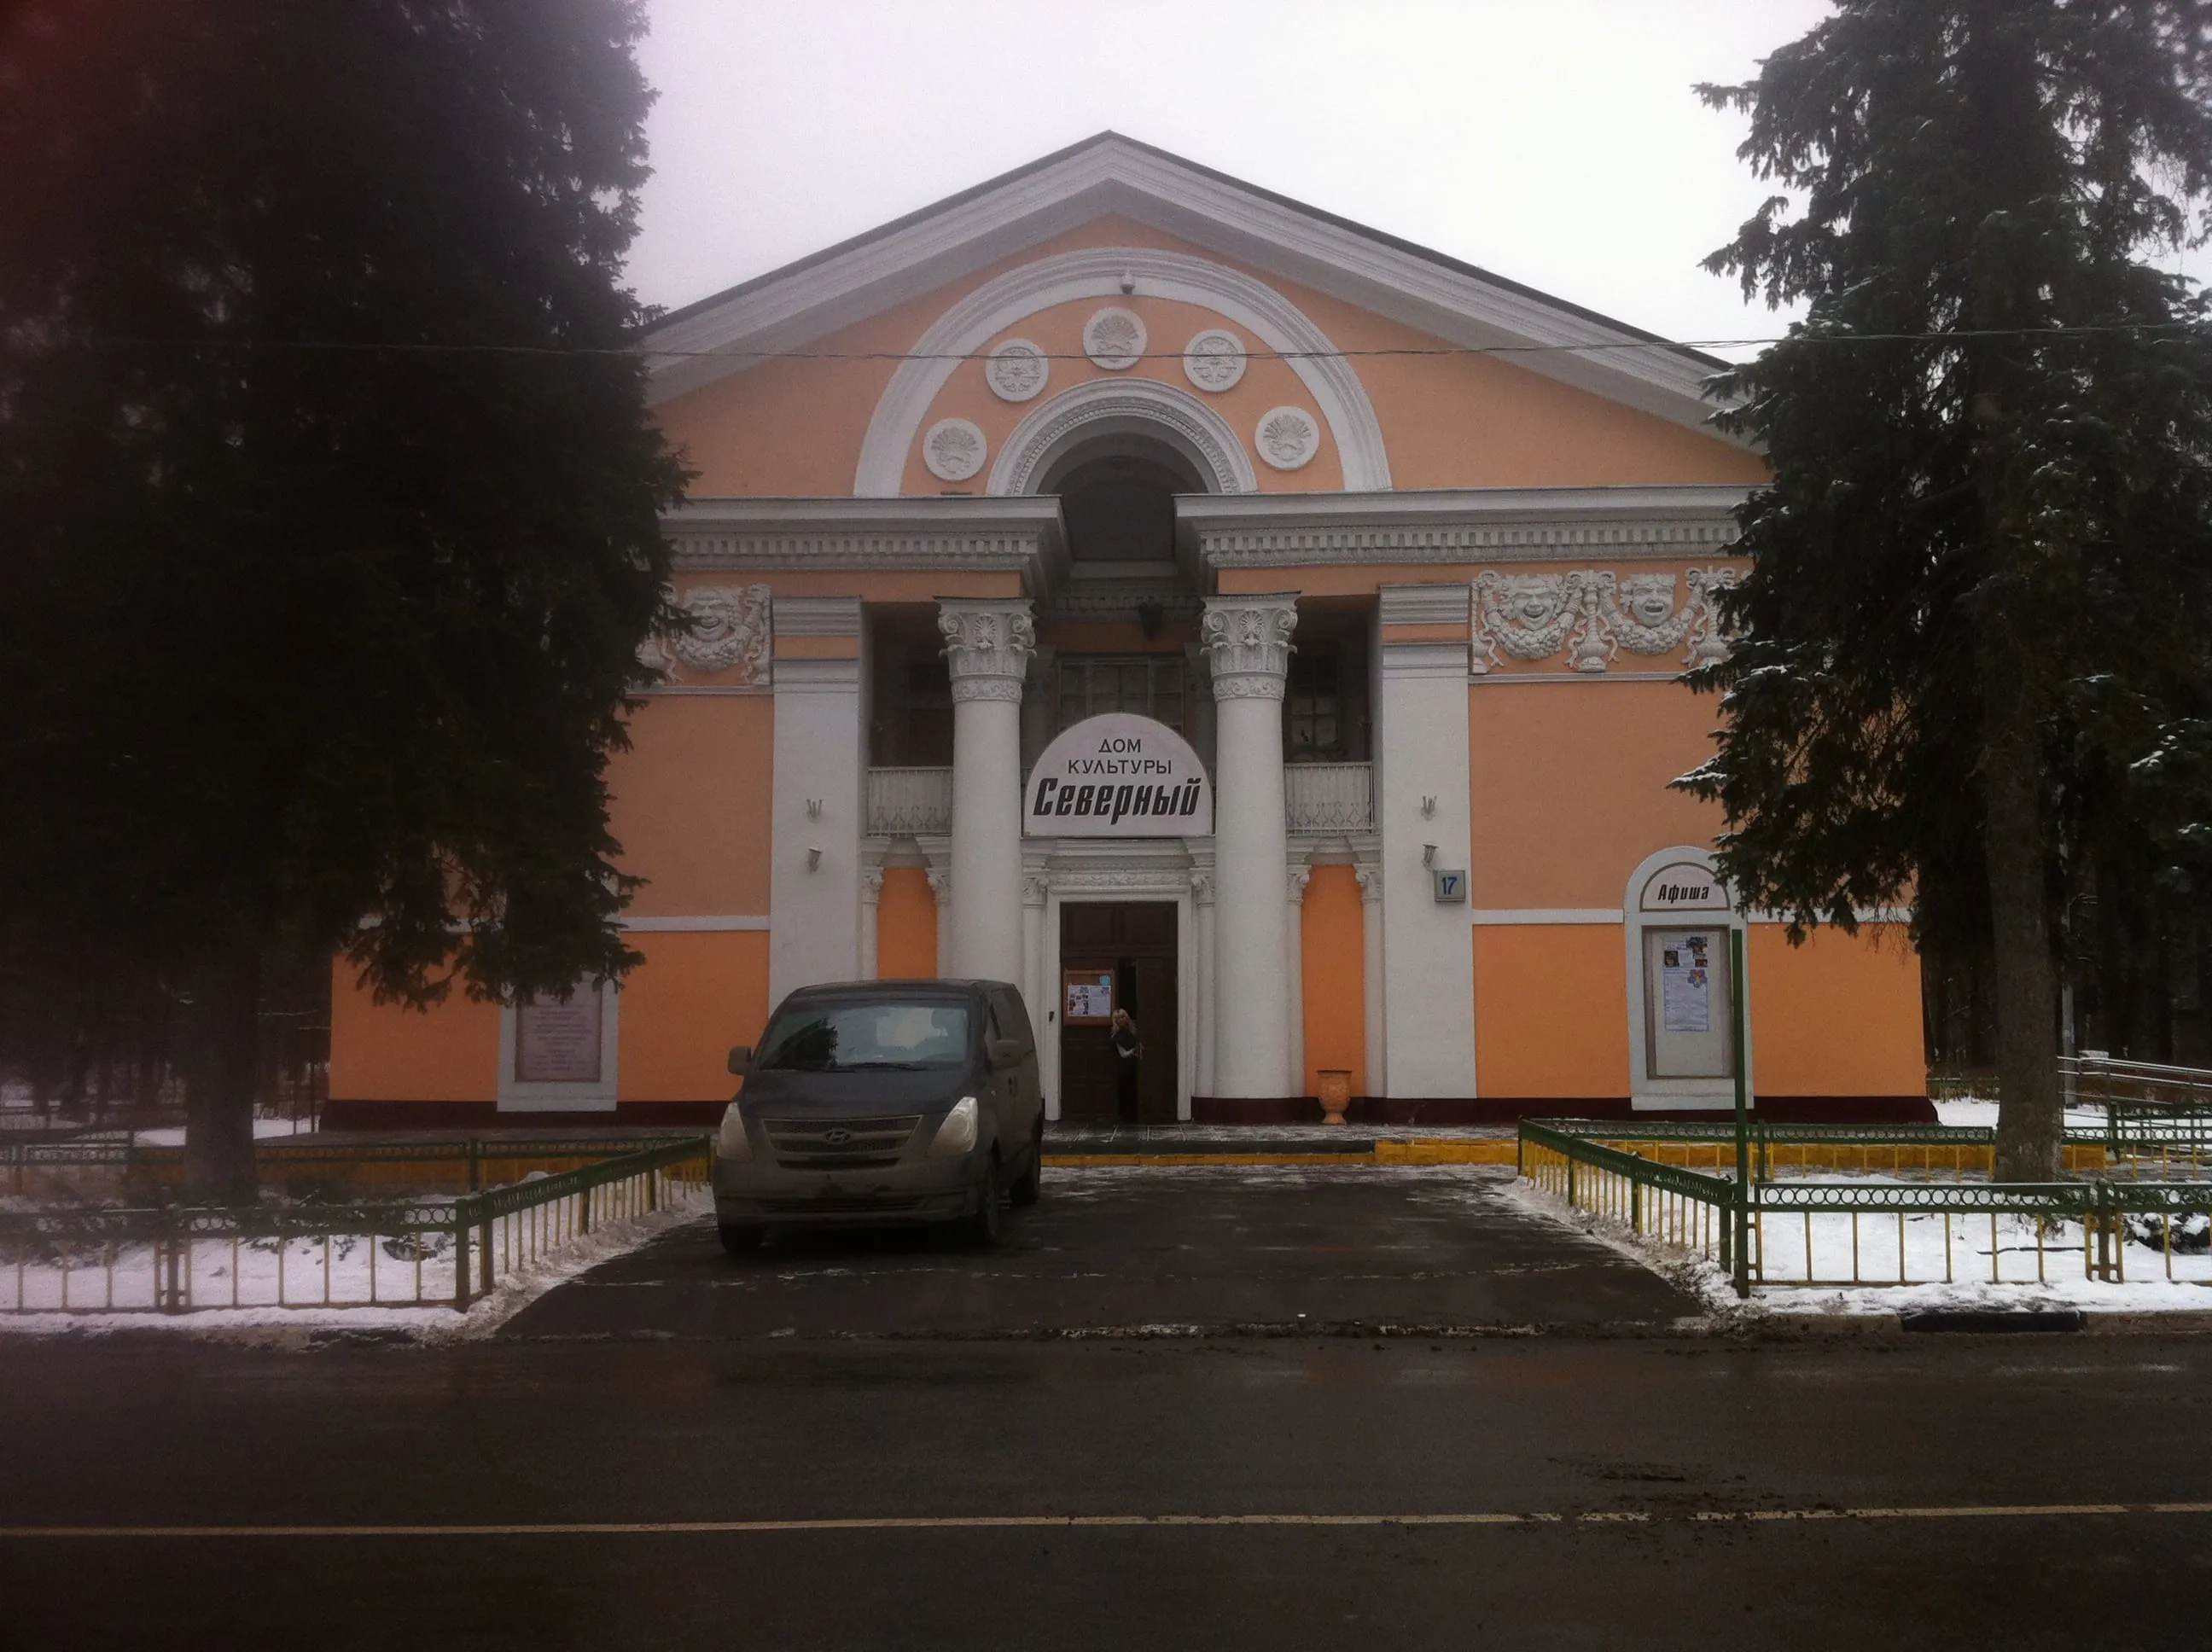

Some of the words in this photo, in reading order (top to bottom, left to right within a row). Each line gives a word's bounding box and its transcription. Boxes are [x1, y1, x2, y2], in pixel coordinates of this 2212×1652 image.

[1098, 739, 1141, 753] ДОМ
[1068, 759, 1172, 774] КУЛЬТУРЫ
[1033, 777, 1202, 825] Северный
[1441, 876, 1458, 895] 17
[1658, 884, 1709, 904] Афиша
